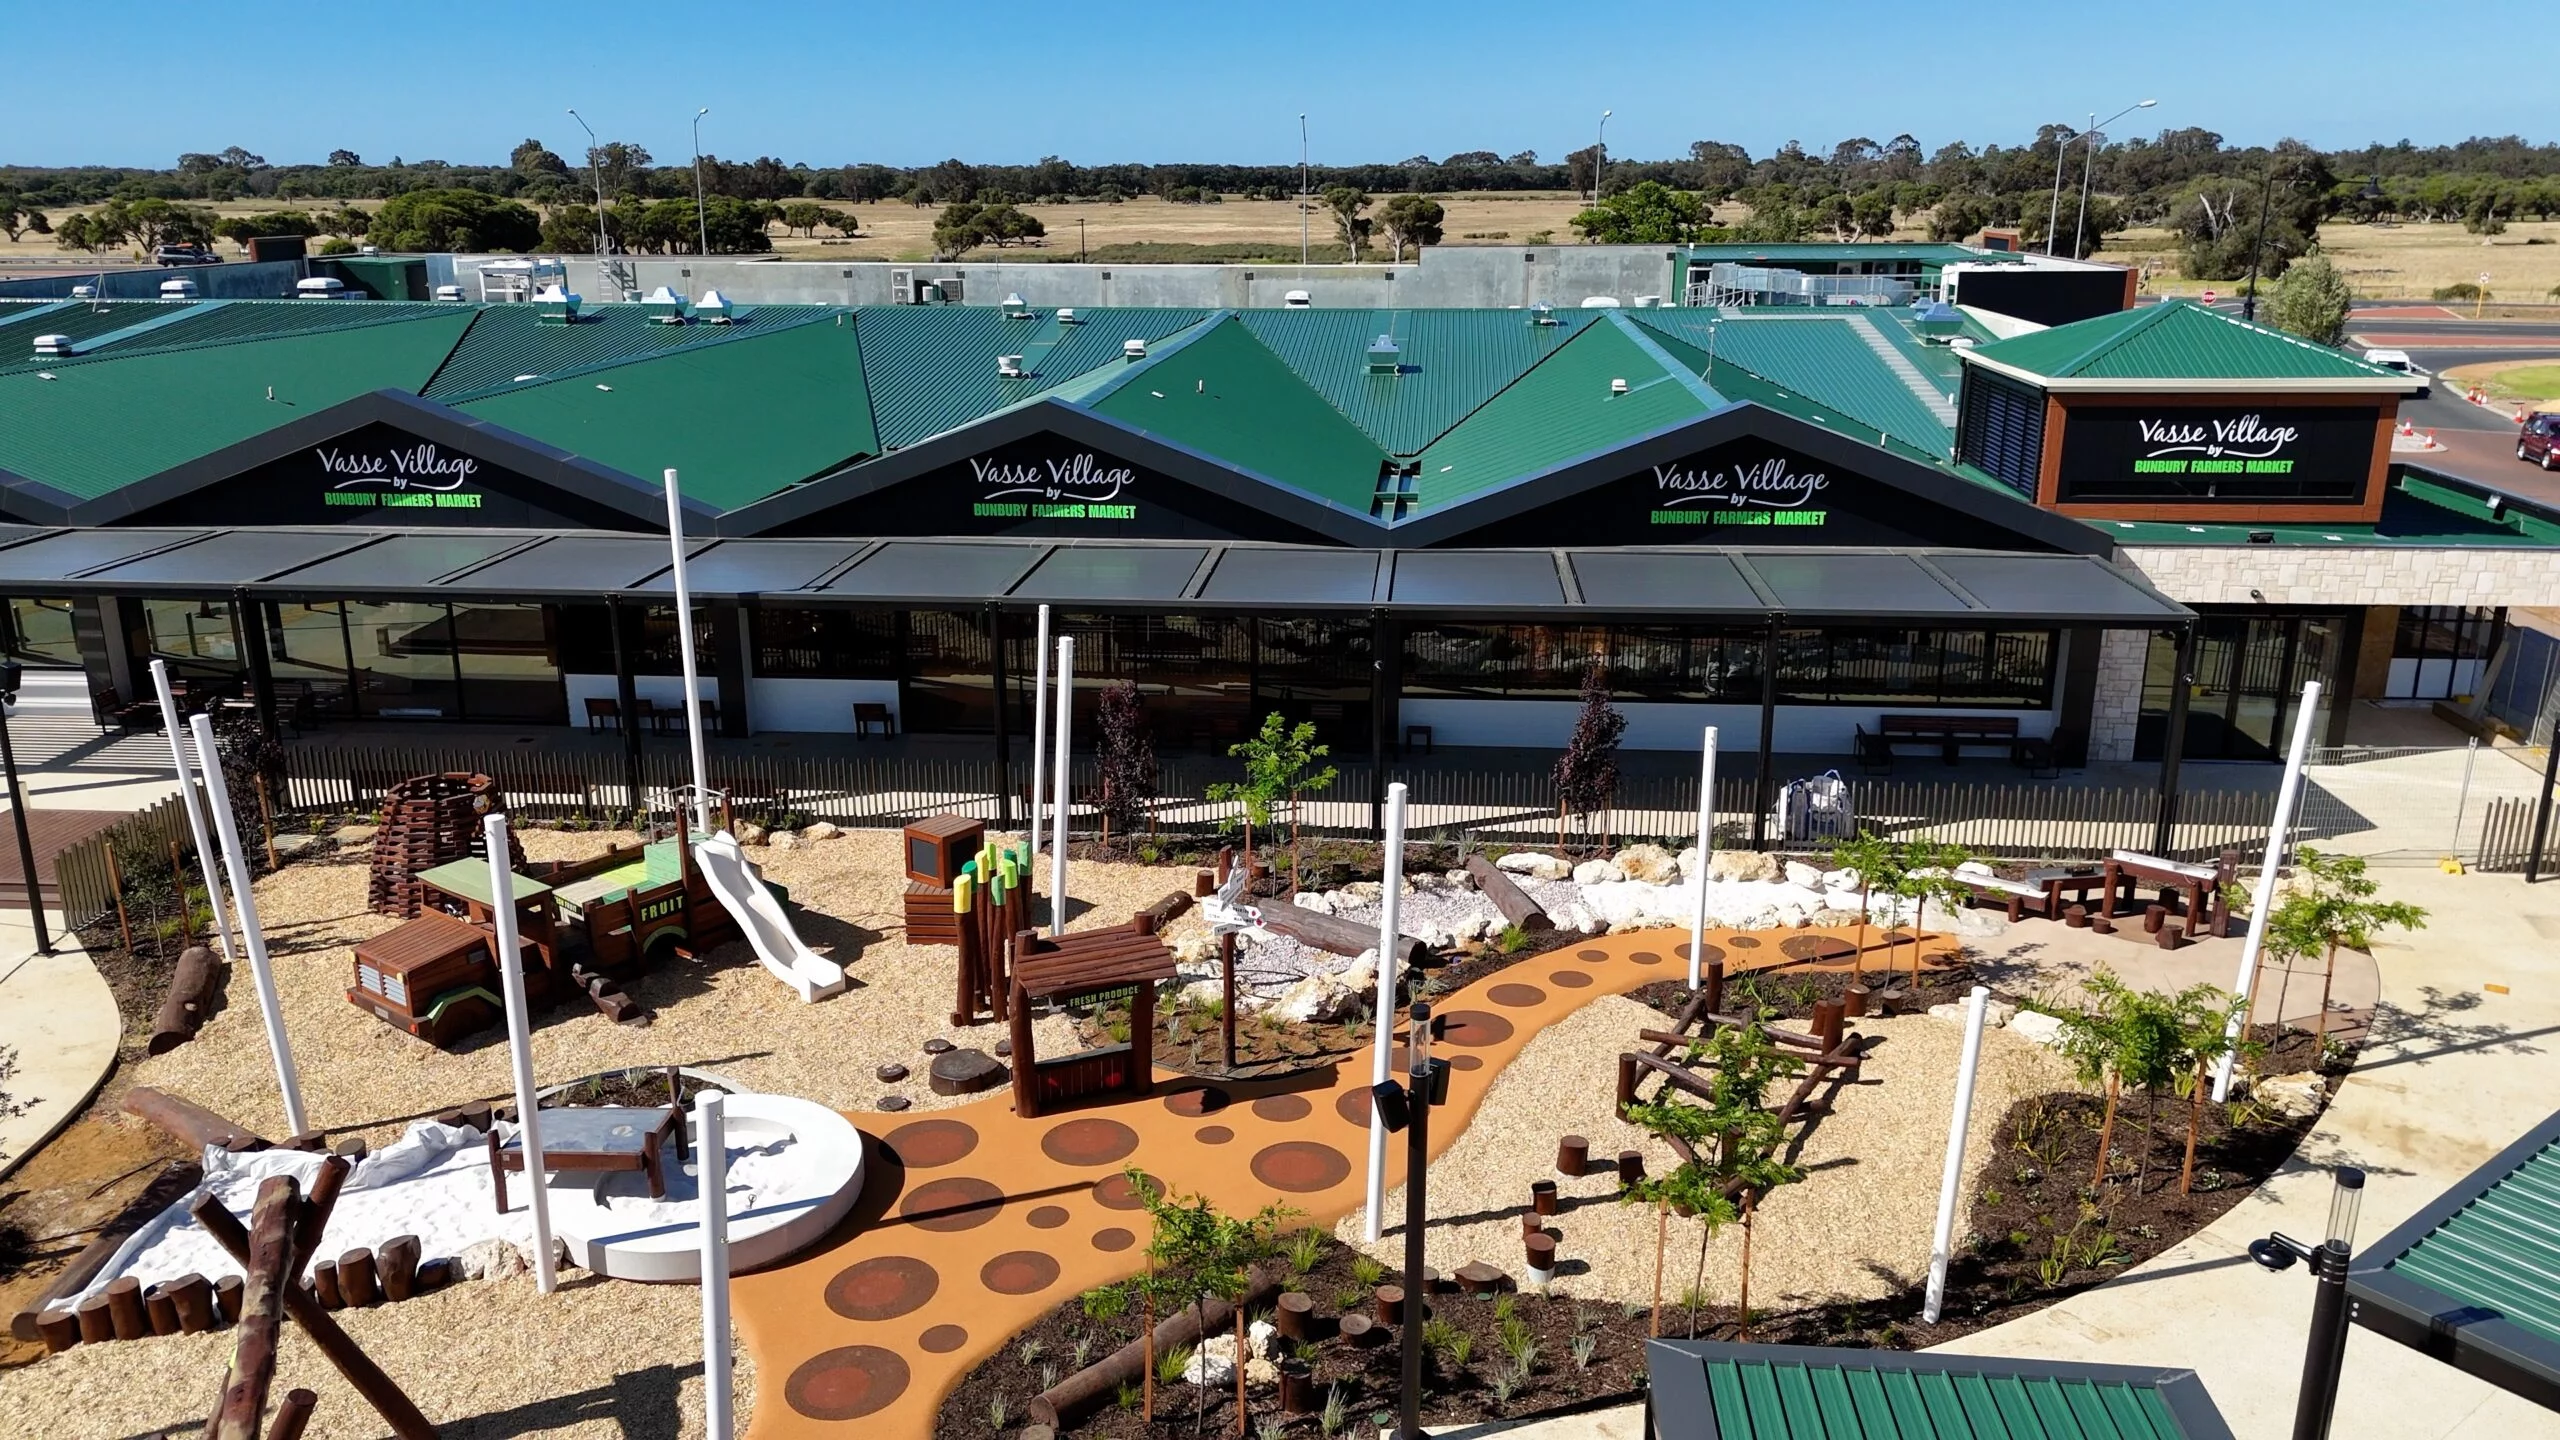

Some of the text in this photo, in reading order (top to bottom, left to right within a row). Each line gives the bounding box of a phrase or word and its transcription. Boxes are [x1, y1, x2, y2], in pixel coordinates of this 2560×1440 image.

[2139, 414, 2298, 457] Vasse Village
[2207, 444, 2223, 458] by
[317, 444, 478, 490] Vasse Village
[2134, 460, 2294, 473] BUNBURY FARMERS MARKET
[393, 476, 408, 490] by
[970, 453, 1135, 501] Vasse Village
[1653, 458, 1830, 507] Vasse Village
[324, 492, 482, 508] BUNBURY FARMERS MARKET
[1046, 487, 1061, 500] by
[1730, 493, 1747, 507] by
[973, 503, 1136, 519] BUNBURY FARMERS MARKET
[1650, 510, 1827, 526] BUNBURY FARMERS MARKET
[641, 895, 684, 922] FRUIT
[1069, 985, 1139, 1008] FRESH PRODUCE
